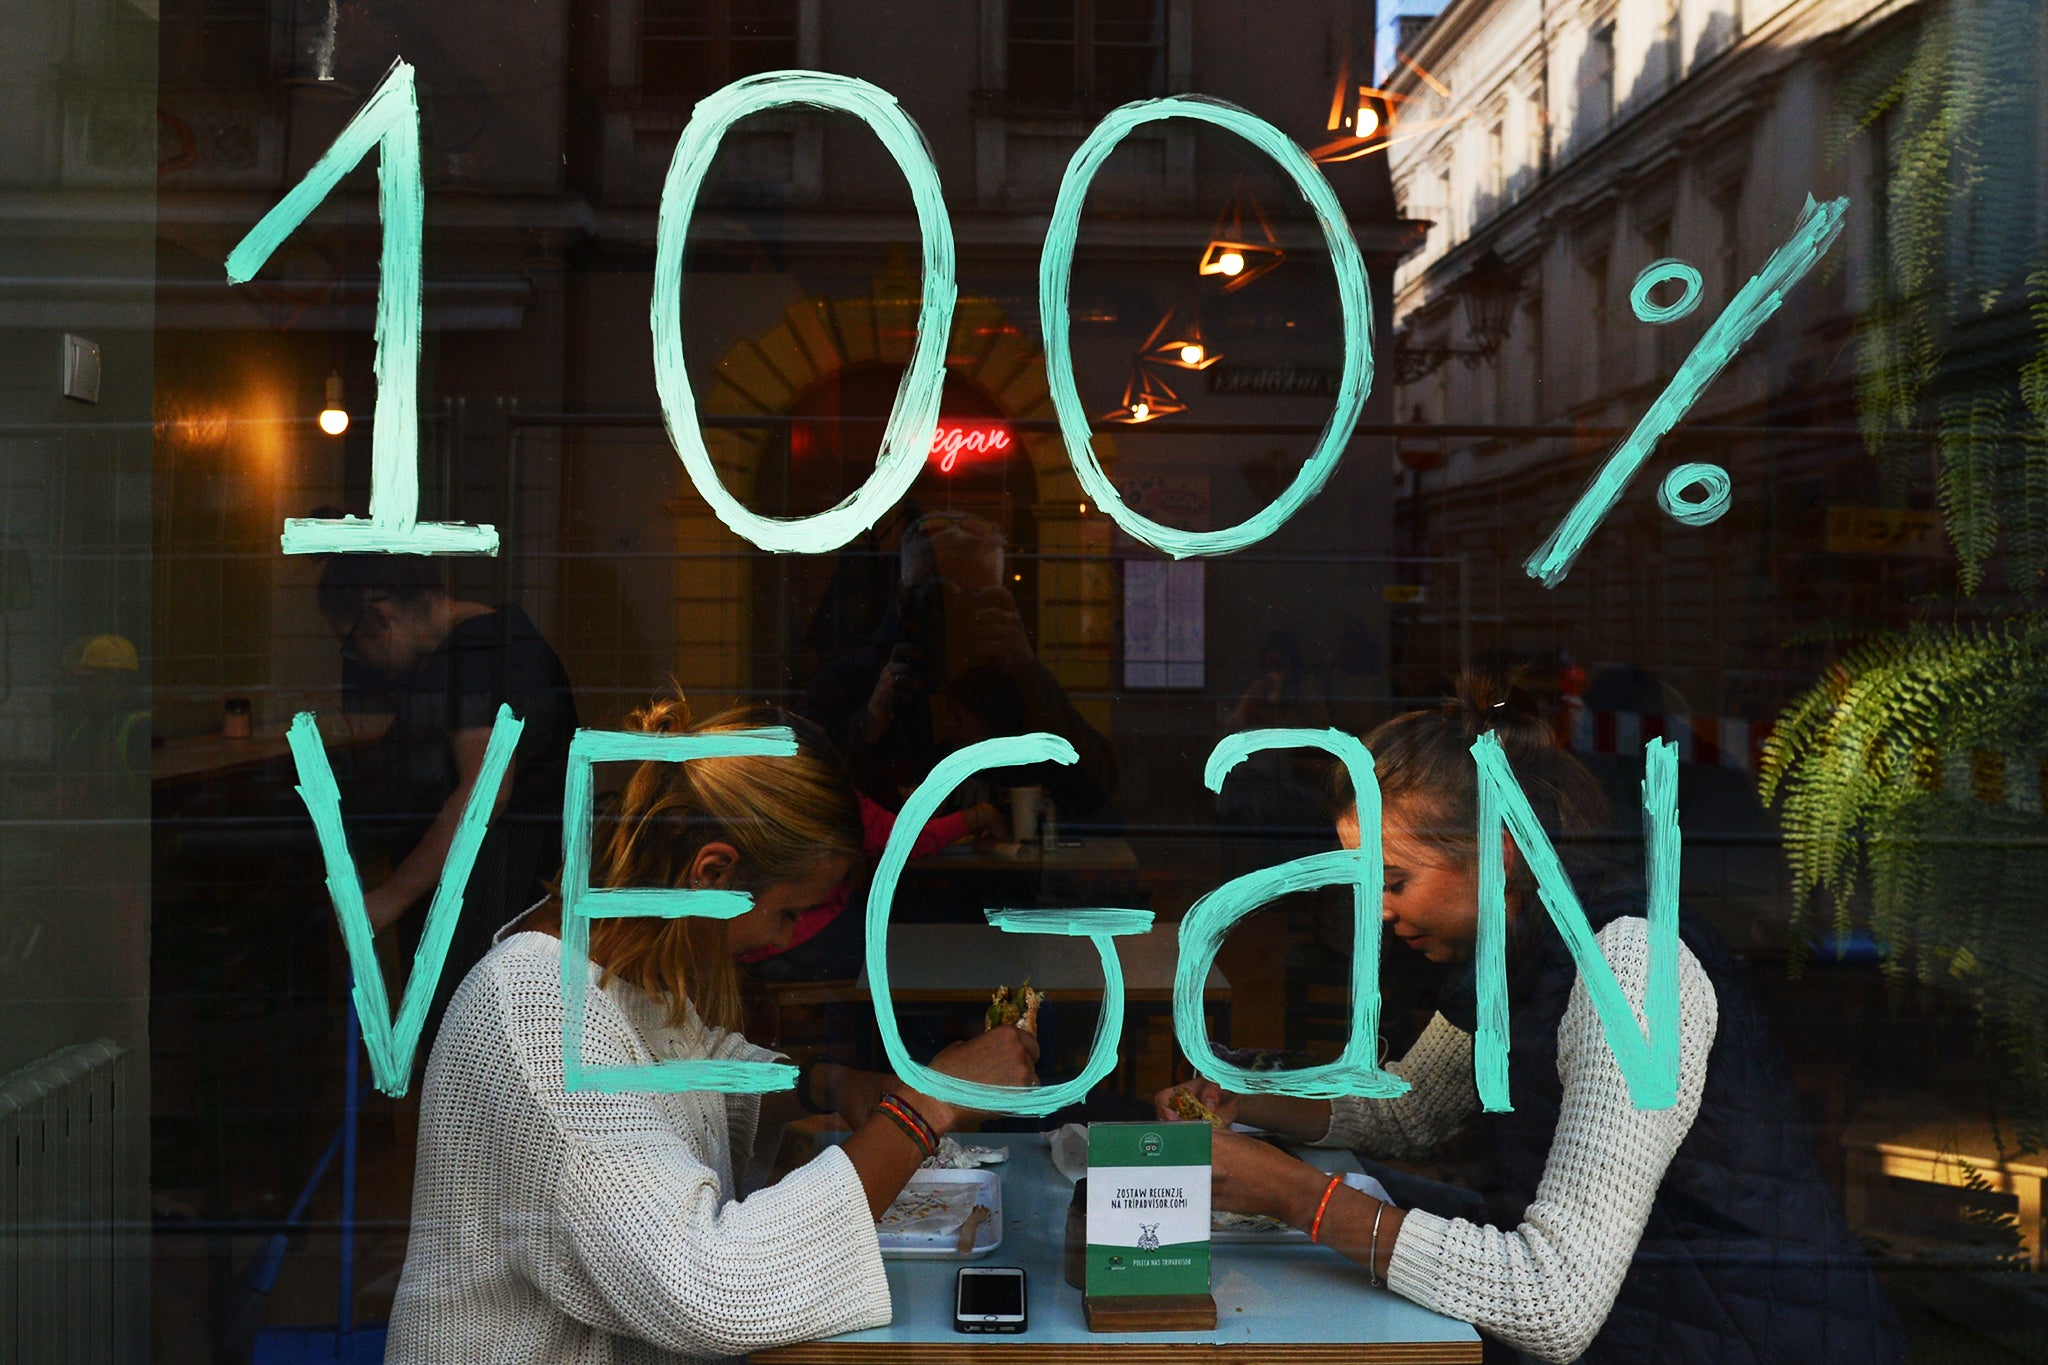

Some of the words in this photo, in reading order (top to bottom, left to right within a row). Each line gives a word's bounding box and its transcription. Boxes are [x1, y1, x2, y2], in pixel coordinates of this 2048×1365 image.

[225, 58, 1849, 588] 100%
[929, 426, 1011, 472] egan
[1111, 1199, 1121, 1209] NA
[1116, 1188, 1147, 1198] ZOSTAW
